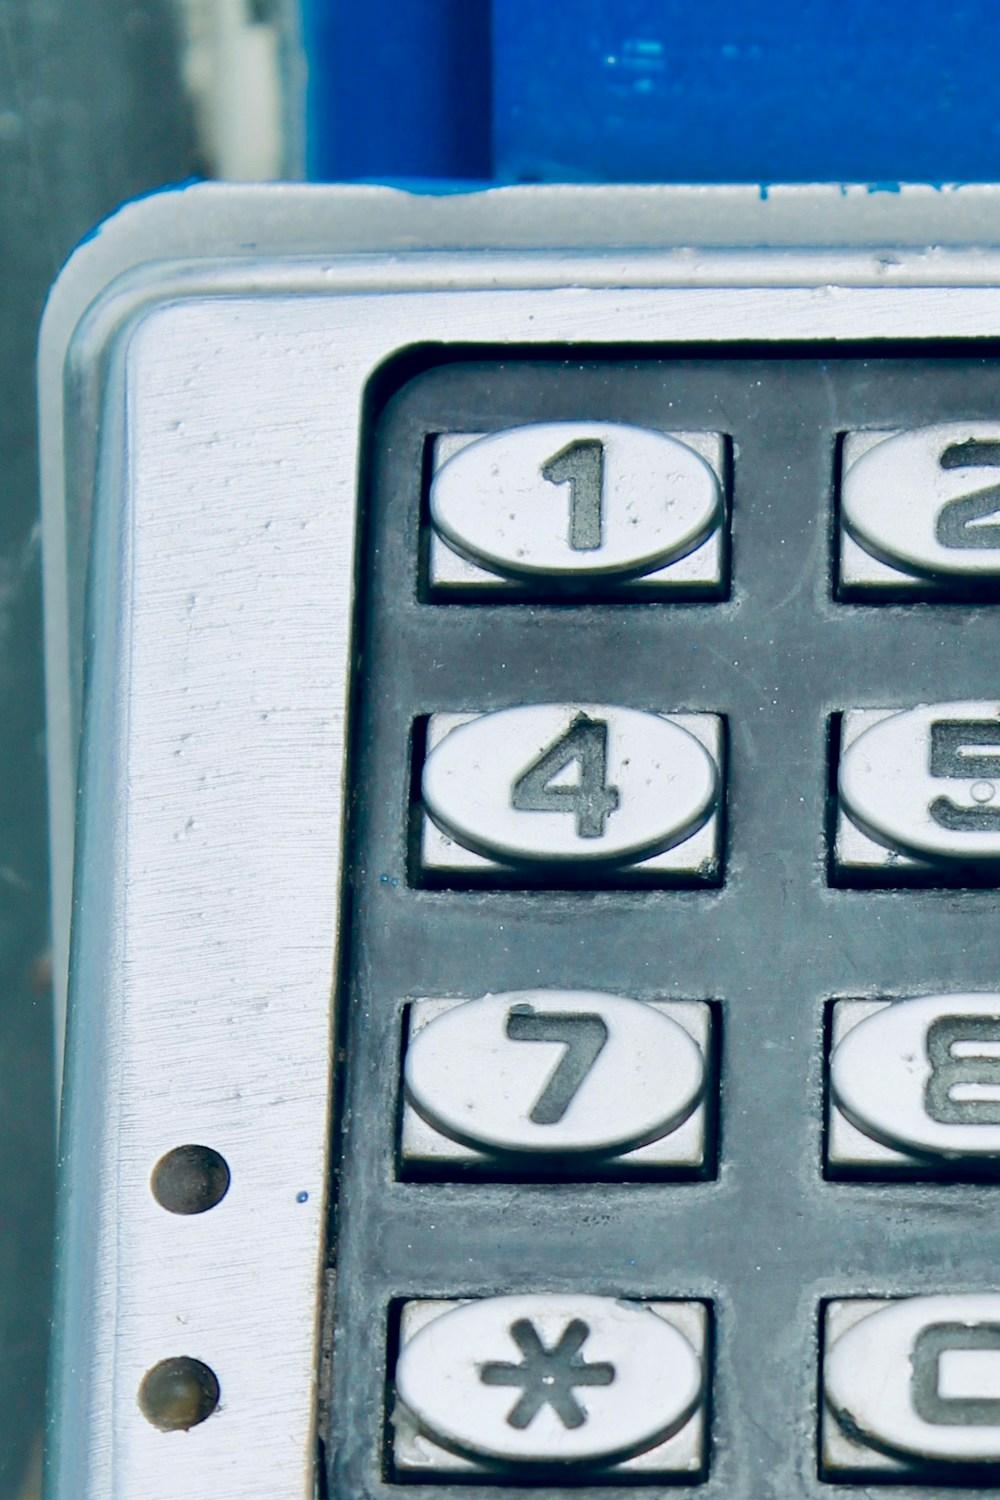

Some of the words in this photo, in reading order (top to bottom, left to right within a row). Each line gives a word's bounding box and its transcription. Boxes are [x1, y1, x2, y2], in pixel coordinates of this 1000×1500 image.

[543, 438, 606, 551] 1
[511, 712, 620, 839] 4
[505, 1006, 609, 1125] 7
